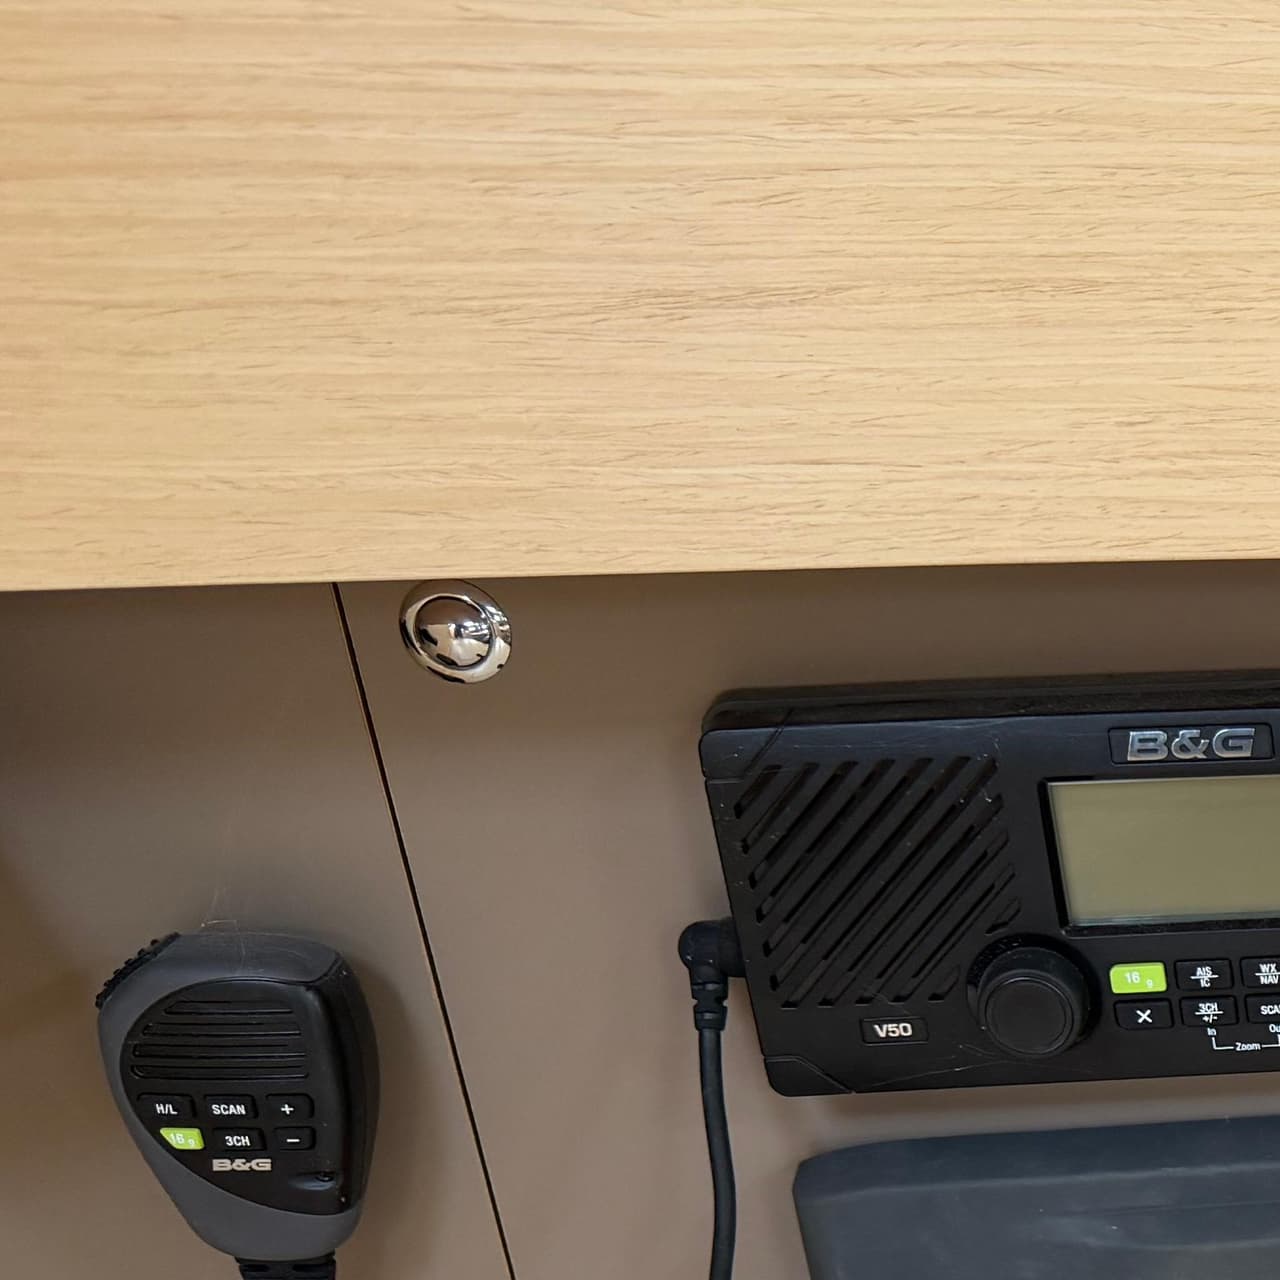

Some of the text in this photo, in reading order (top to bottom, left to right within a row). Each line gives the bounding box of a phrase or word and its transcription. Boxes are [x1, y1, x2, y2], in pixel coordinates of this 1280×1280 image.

[1126, 726, 1256, 762] B&G
[1195, 965, 1213, 977] AIS
[1258, 963, 1278, 974] WX
[1124, 971, 1141, 985] 16
[1199, 978, 1211, 989] IC
[1259, 974, 1280, 986] NAV
[1198, 1002, 1219, 1013] 3CH
[873, 1022, 913, 1038] V50
[1207, 1027, 1217, 1037] In
[1235, 1041, 1262, 1053] Zoom
[155, 1103, 179, 1116] H/L
[211, 1103, 246, 1116] SCAN
[169, 1132, 185, 1145] 16
[224, 1134, 251, 1147] 3CH
[211, 1158, 272, 1172] B&G
